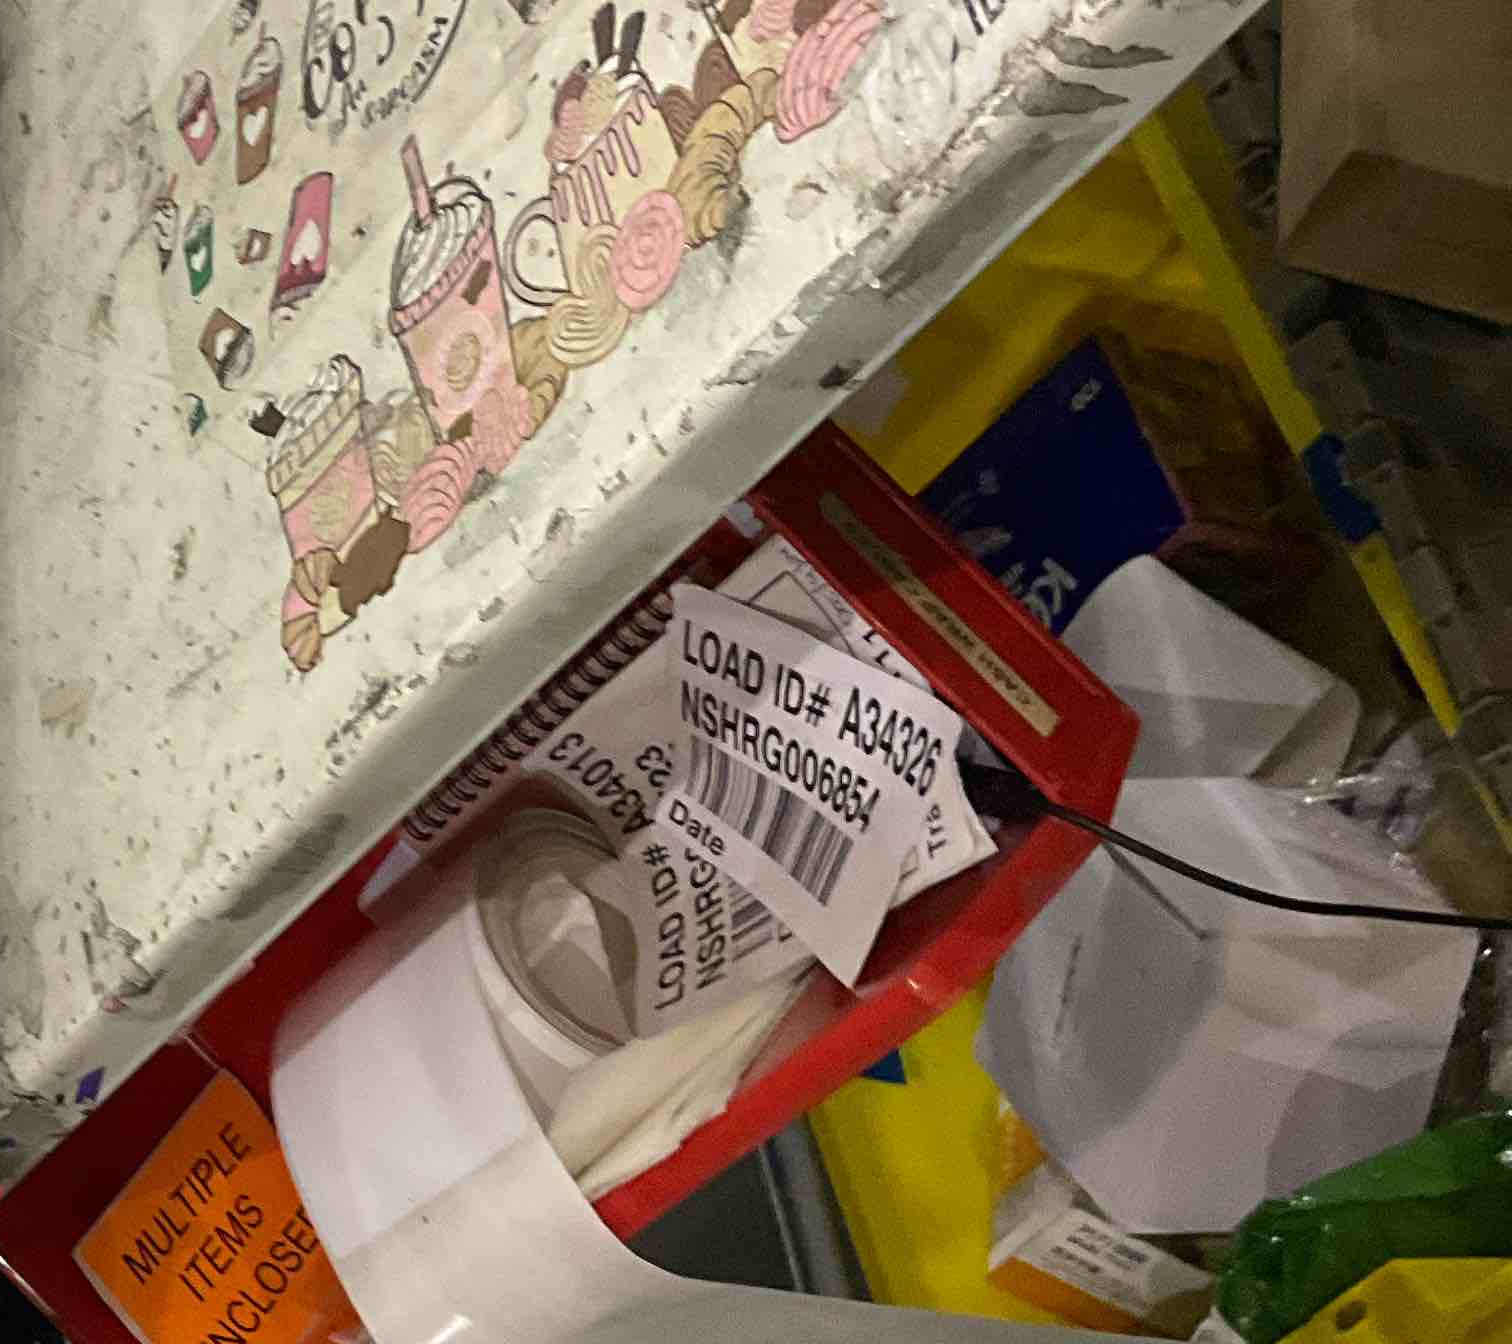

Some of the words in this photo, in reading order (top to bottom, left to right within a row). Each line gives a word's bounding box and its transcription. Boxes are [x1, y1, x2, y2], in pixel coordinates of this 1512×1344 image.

[681, 679, 881, 834] NSHRG006854
[682, 619, 766, 696] LOAD
[774, 663, 831, 727] ID#
[838, 686, 942, 797] A34326
[549, 732, 655, 835] A34013
[669, 799, 726, 856] Date
[641, 842, 682, 908] ID#
[654, 910, 686, 1011] LOAD
[121, 1121, 253, 1286] MULTIPLE
[178, 1193, 265, 1303] ITEMS
